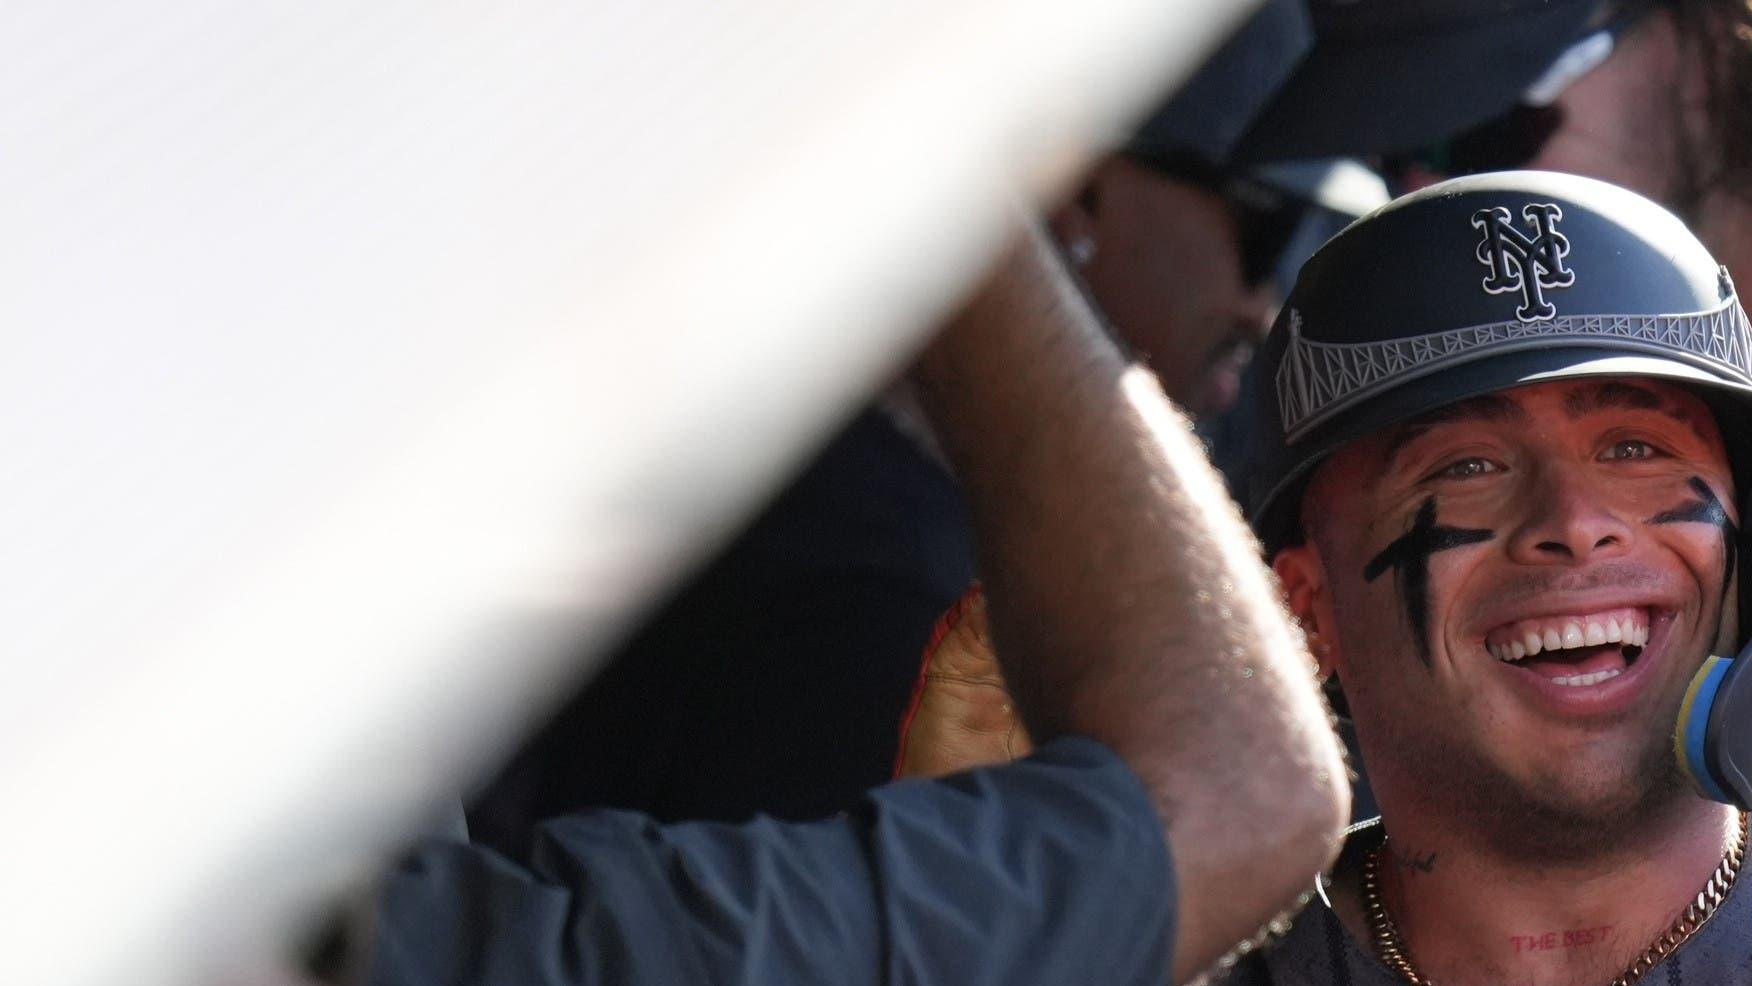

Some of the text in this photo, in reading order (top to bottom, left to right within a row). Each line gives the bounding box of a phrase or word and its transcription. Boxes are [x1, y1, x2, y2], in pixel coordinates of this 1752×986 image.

[1471, 203, 1575, 322] NY
[1510, 925, 1612, 953] THE BEST
